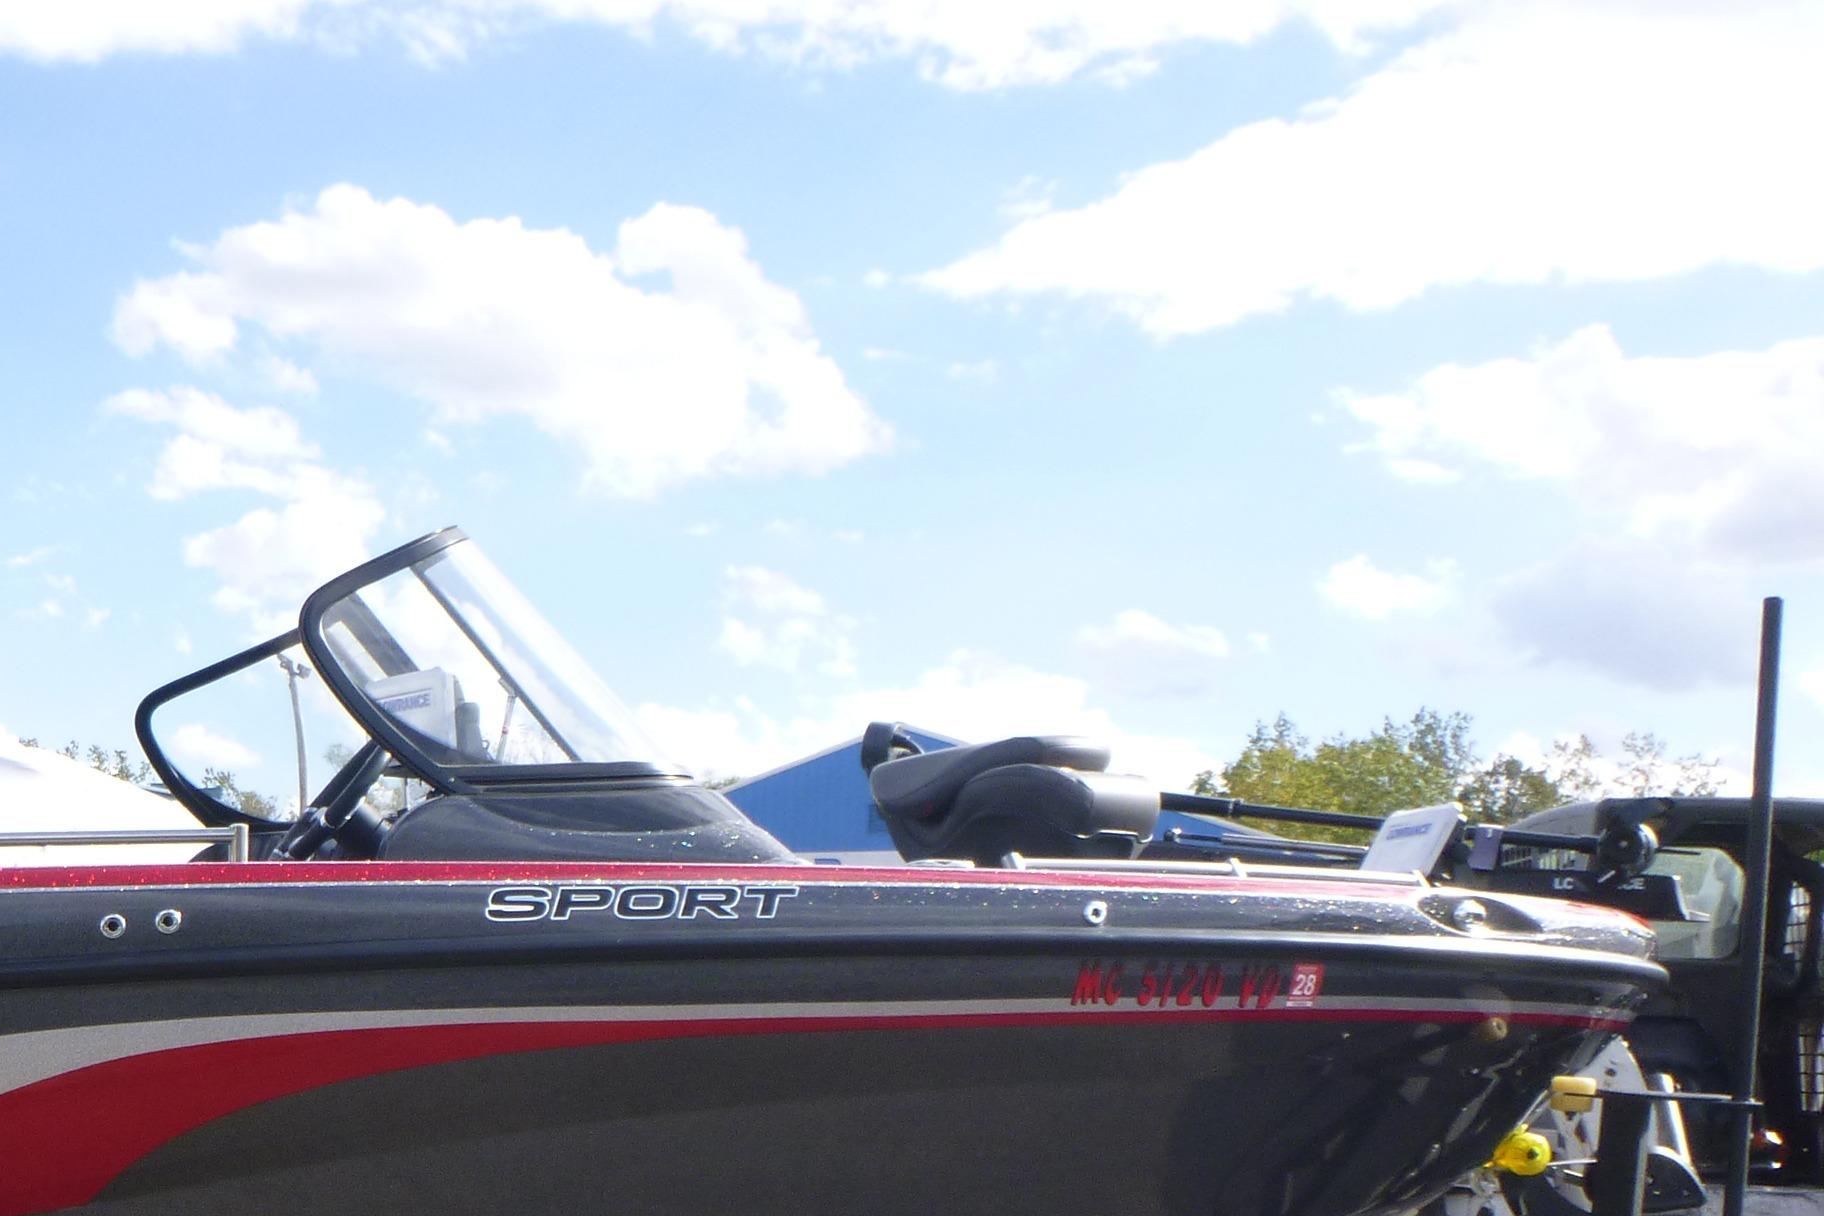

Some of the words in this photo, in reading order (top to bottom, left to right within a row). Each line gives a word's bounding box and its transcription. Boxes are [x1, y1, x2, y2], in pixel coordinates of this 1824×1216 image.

[485, 886, 799, 921] SPORT
[1071, 960, 1123, 1006] MC
[1291, 973, 1317, 996] 28
